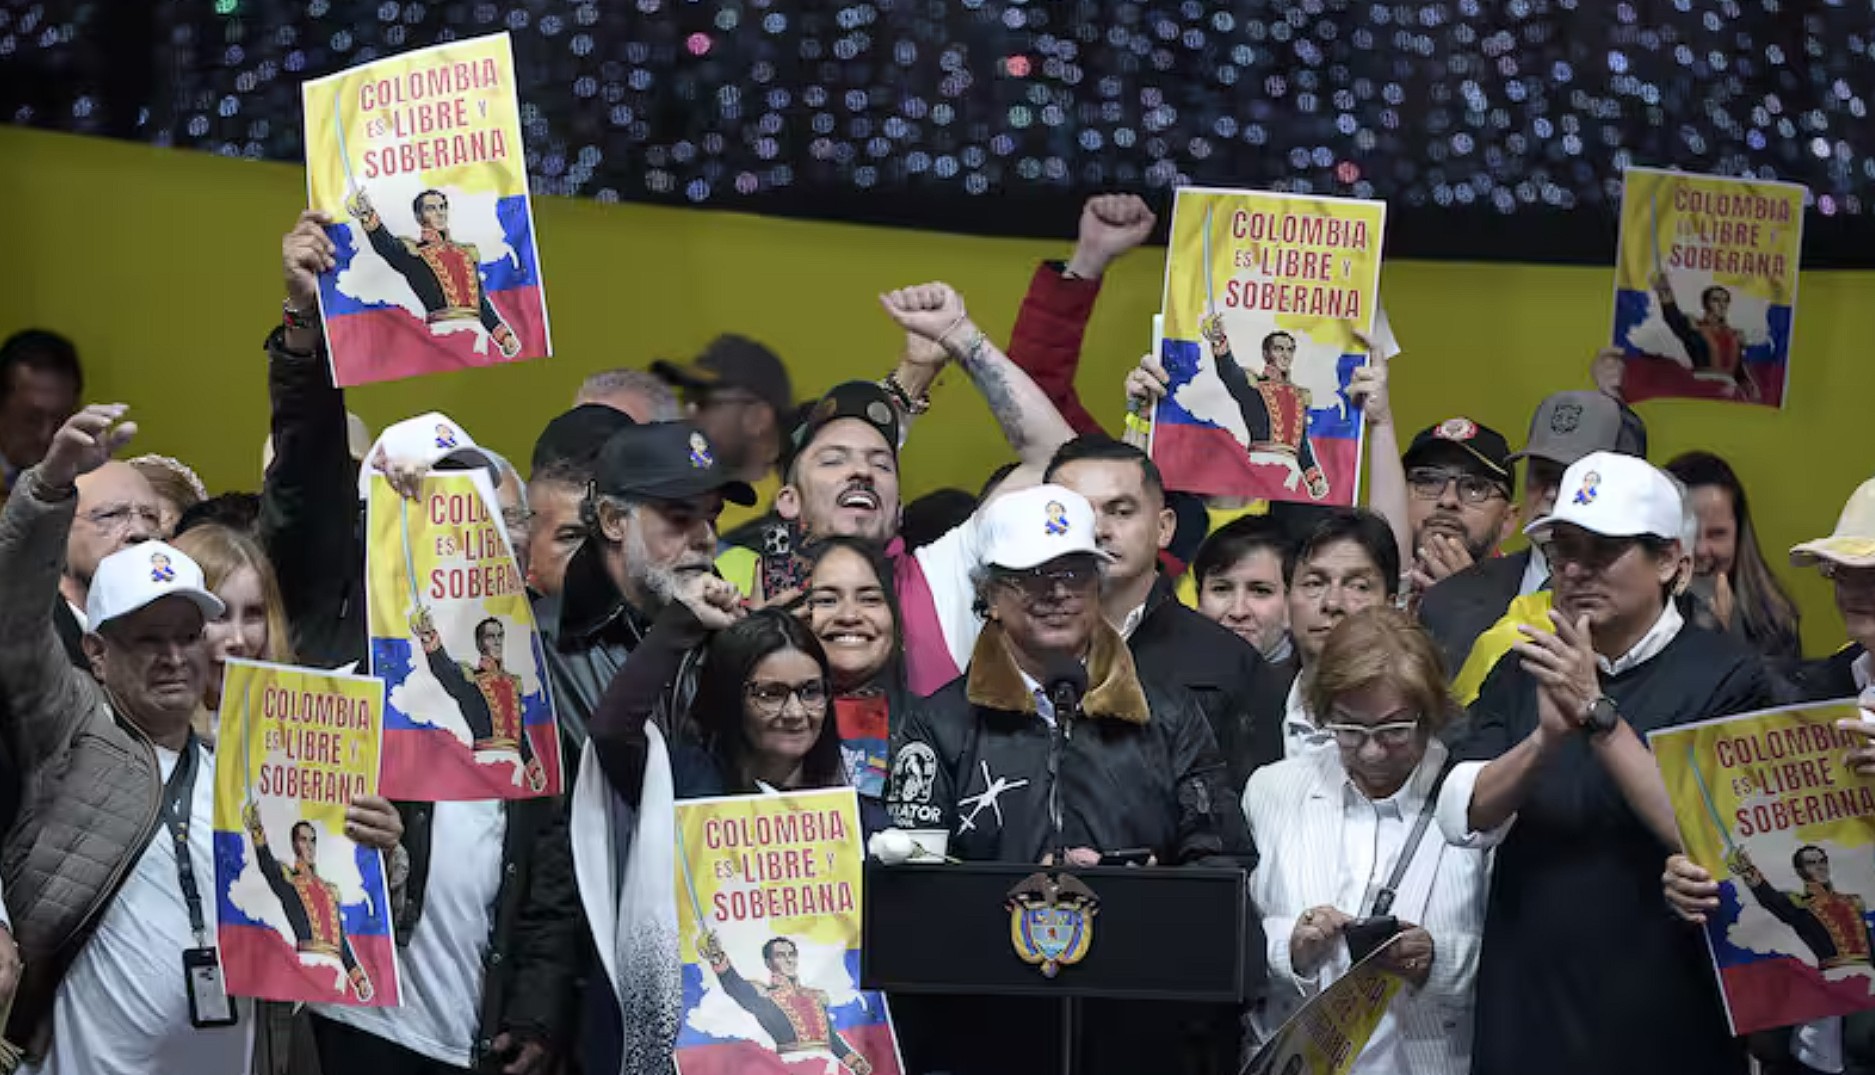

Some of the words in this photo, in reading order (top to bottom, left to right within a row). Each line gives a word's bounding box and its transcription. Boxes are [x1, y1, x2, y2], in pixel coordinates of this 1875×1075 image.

[361, 58, 498, 112] COLOMBIA
[366, 118, 386, 138] ES
[394, 97, 469, 138] LIBRE
[477, 98, 486, 118] Y
[363, 128, 506, 179] SOBERANA
[1673, 186, 1790, 222] COLOMBIA
[1232, 210, 1367, 250] COLOMBIA
[1699, 219, 1761, 248] LIBRE
[1234, 249, 1253, 267] ES
[1261, 247, 1333, 281] LIBRE
[1343, 259, 1352, 276] Y
[1669, 243, 1786, 278] SOBERANA
[1225, 279, 1360, 318] SOBERANA
[435, 534, 455, 556] ES
[263, 687, 370, 731] COLOMBIA
[265, 729, 279, 751] ES
[286, 729, 342, 765] LIBRE
[1716, 721, 1856, 769] COLOMBIA
[260, 763, 365, 805] SOBERANA
[1732, 777, 1752, 796] ES
[1758, 757, 1835, 796] LIBRE
[706, 810, 844, 849] COLOMBIA
[1736, 785, 1875, 838] SOBERANA
[714, 860, 734, 879] ES
[743, 848, 816, 883] LIBRE
[826, 852, 835, 871] Y
[713, 881, 854, 922] SOBERANA
